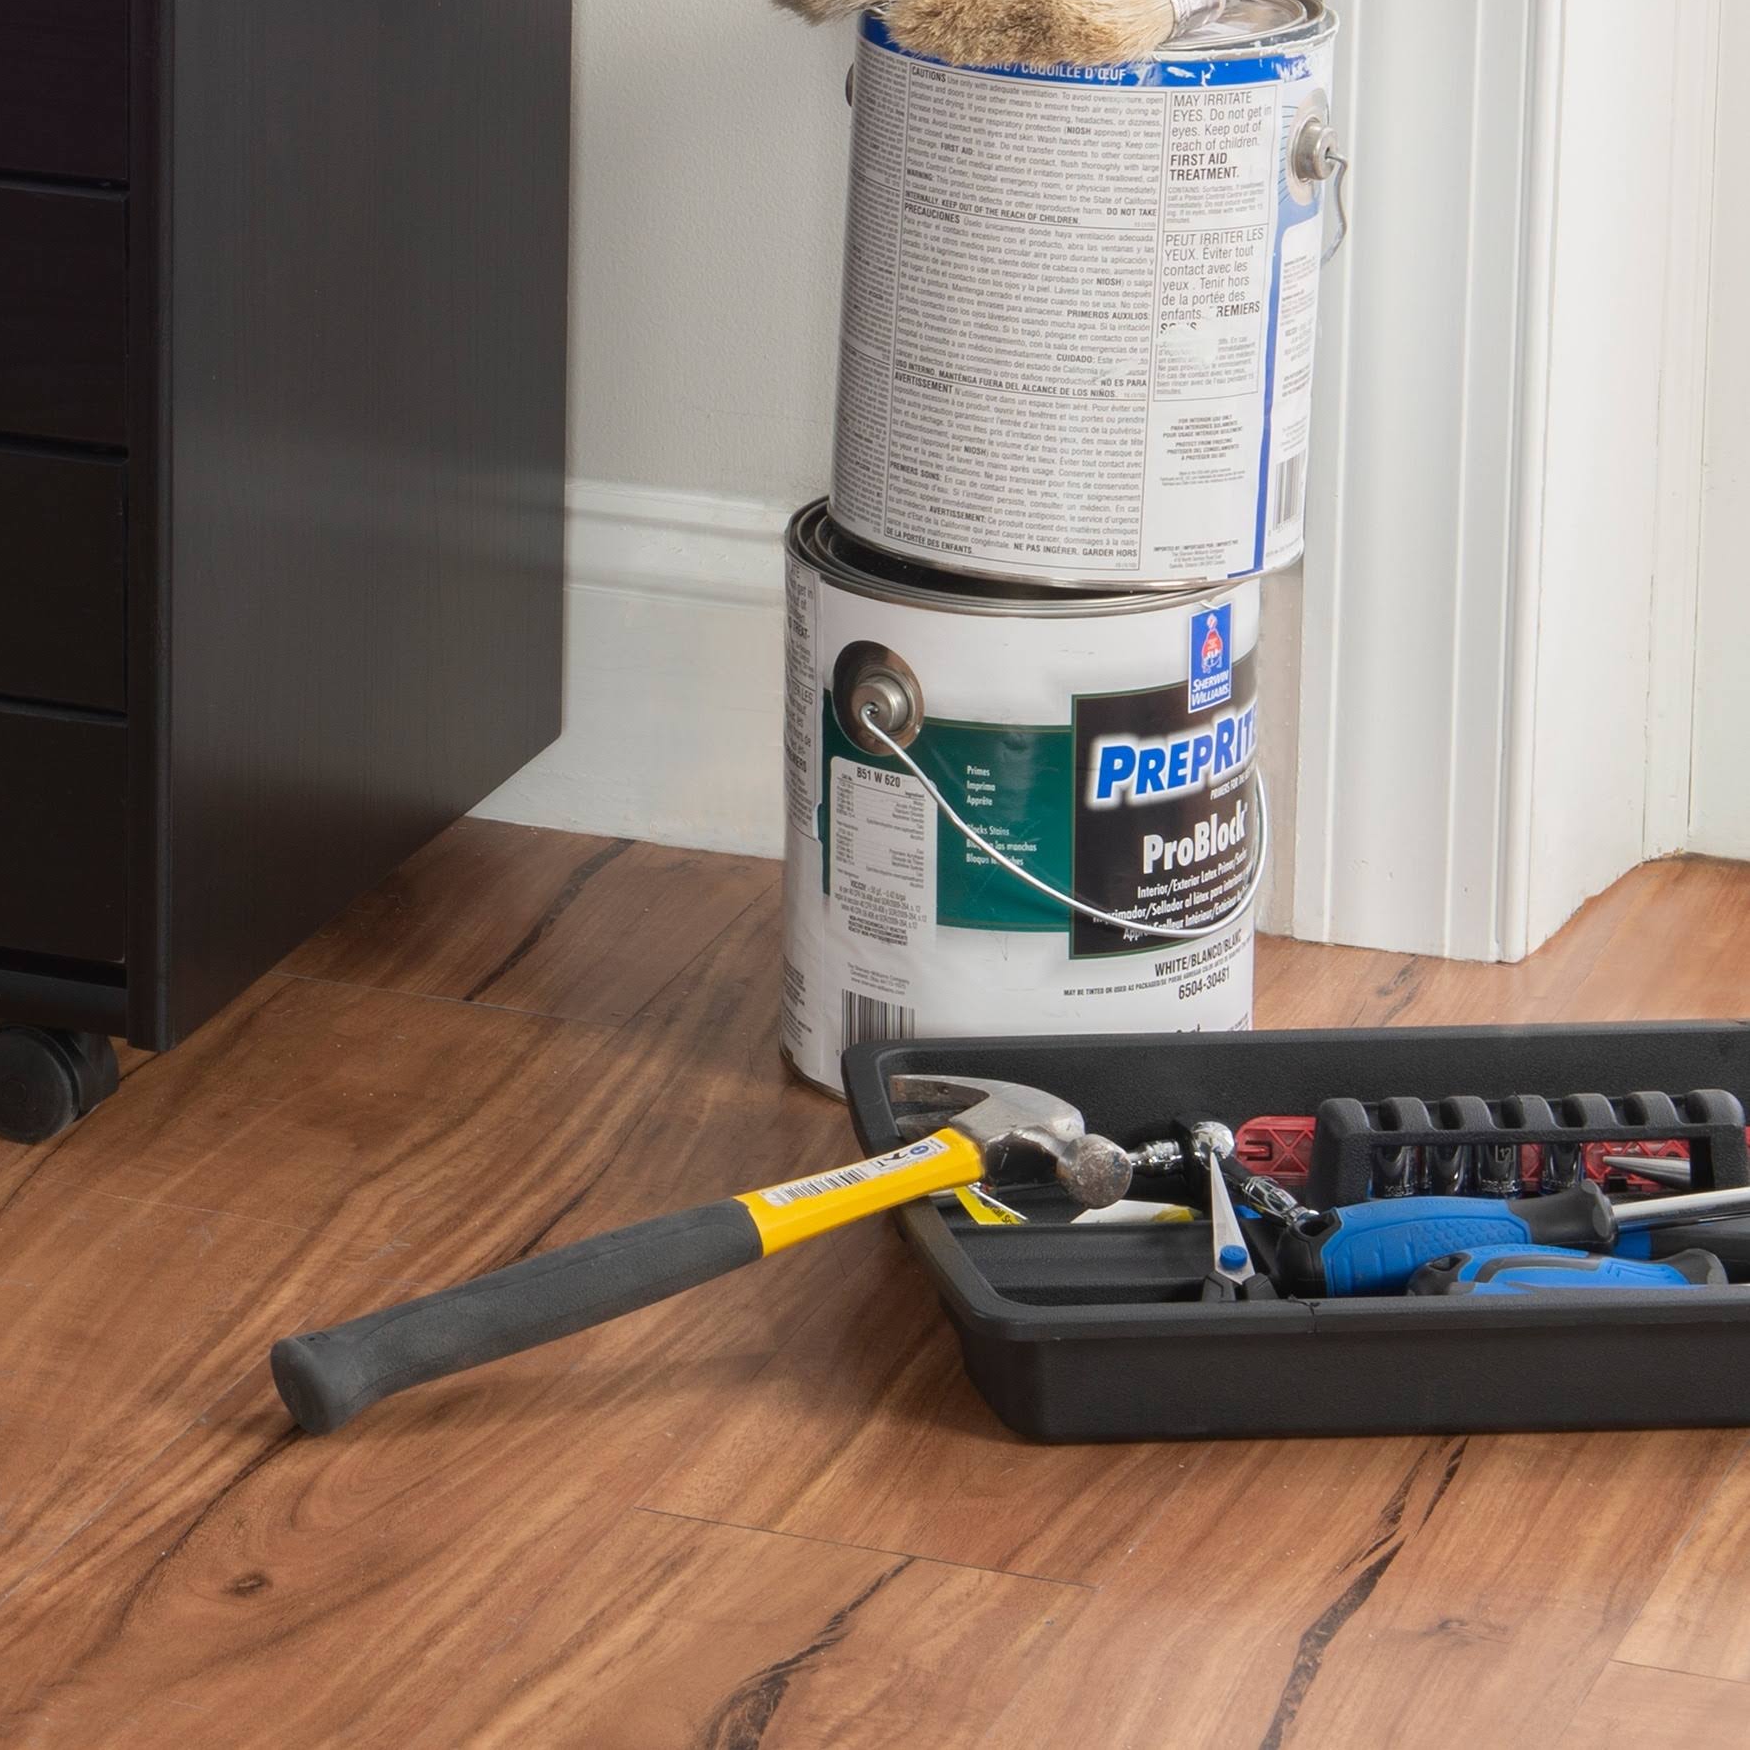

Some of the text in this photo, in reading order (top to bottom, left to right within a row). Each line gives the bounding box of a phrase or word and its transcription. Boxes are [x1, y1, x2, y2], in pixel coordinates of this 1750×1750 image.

[911, 65, 946, 83] CAUTIONS
[1173, 91, 1252, 107] MAY IRRITATE
[1172, 108, 1206, 122] EYES.
[1210, 108, 1224, 121] Do
[1228, 108, 1244, 119] not
[1247, 106, 1262, 119] get
[1171, 120, 1262, 139] eyes. Keep out of
[1171, 136, 1259, 152] reach of children.
[1170, 152, 1228, 167] FIRST AID
[1170, 166, 1239, 181] TREATMENT.
[904, 202, 961, 224] PRECAUCIONES
[942, 199, 958, 209] KEEP
[959, 202, 973, 211] OUT
[974, 205, 983, 213] OF
[986, 207, 998, 216] THE
[1000, 209, 1026, 219] REACH
[1027, 212, 1037, 221] OF
[1106, 207, 1157, 217] DO NOT TAKE
[1165, 228, 1264, 247] PEUT IRRITER LES
[1164, 244, 1254, 262] YEUX. Éviter tout
[1163, 261, 1248, 276] contact avec les
[1200, 277, 1225, 290] Tenir
[1228, 275, 1250, 287] hors
[1162, 290, 1246, 307] de la portée des
[1066, 309, 1110, 319] PRIMEROS
[1210, 301, 1261, 317] REMIERS
[894, 371, 953, 394] AVERTISSEMENT
[979, 377, 1004, 389] FUERA
[1005, 381, 1020, 391] DEL
[1022, 384, 1057, 394] ALCANCE
[1059, 387, 1070, 395] DE
[1072, 388, 1088, 397] LOS
[1100, 379, 1147, 387] NO ES PARA
[927, 538, 940, 548] DES
[1013, 542, 1023, 550] NE
[1026, 543, 1040, 552] PAS
[1082, 548, 1114, 557] GARDER
[1116, 549, 1137, 557] HORS
[1192, 669, 1230, 693] SHERWIN
[1191, 683, 1229, 707] WILLIAMS
[856, 766, 901, 788] B51 W 620
[966, 765, 990, 777] Primes
[989, 826, 1010, 836] Stains
[1143, 799, 1246, 875] ProBlock
[1006, 841, 1038, 852] manchas
[1137, 874, 1200, 899] Interior/Exterior
[1201, 868, 1218, 883] Latex
[1092, 898, 1184, 925] rimador/Sellador
[1184, 892, 1193, 908] al
